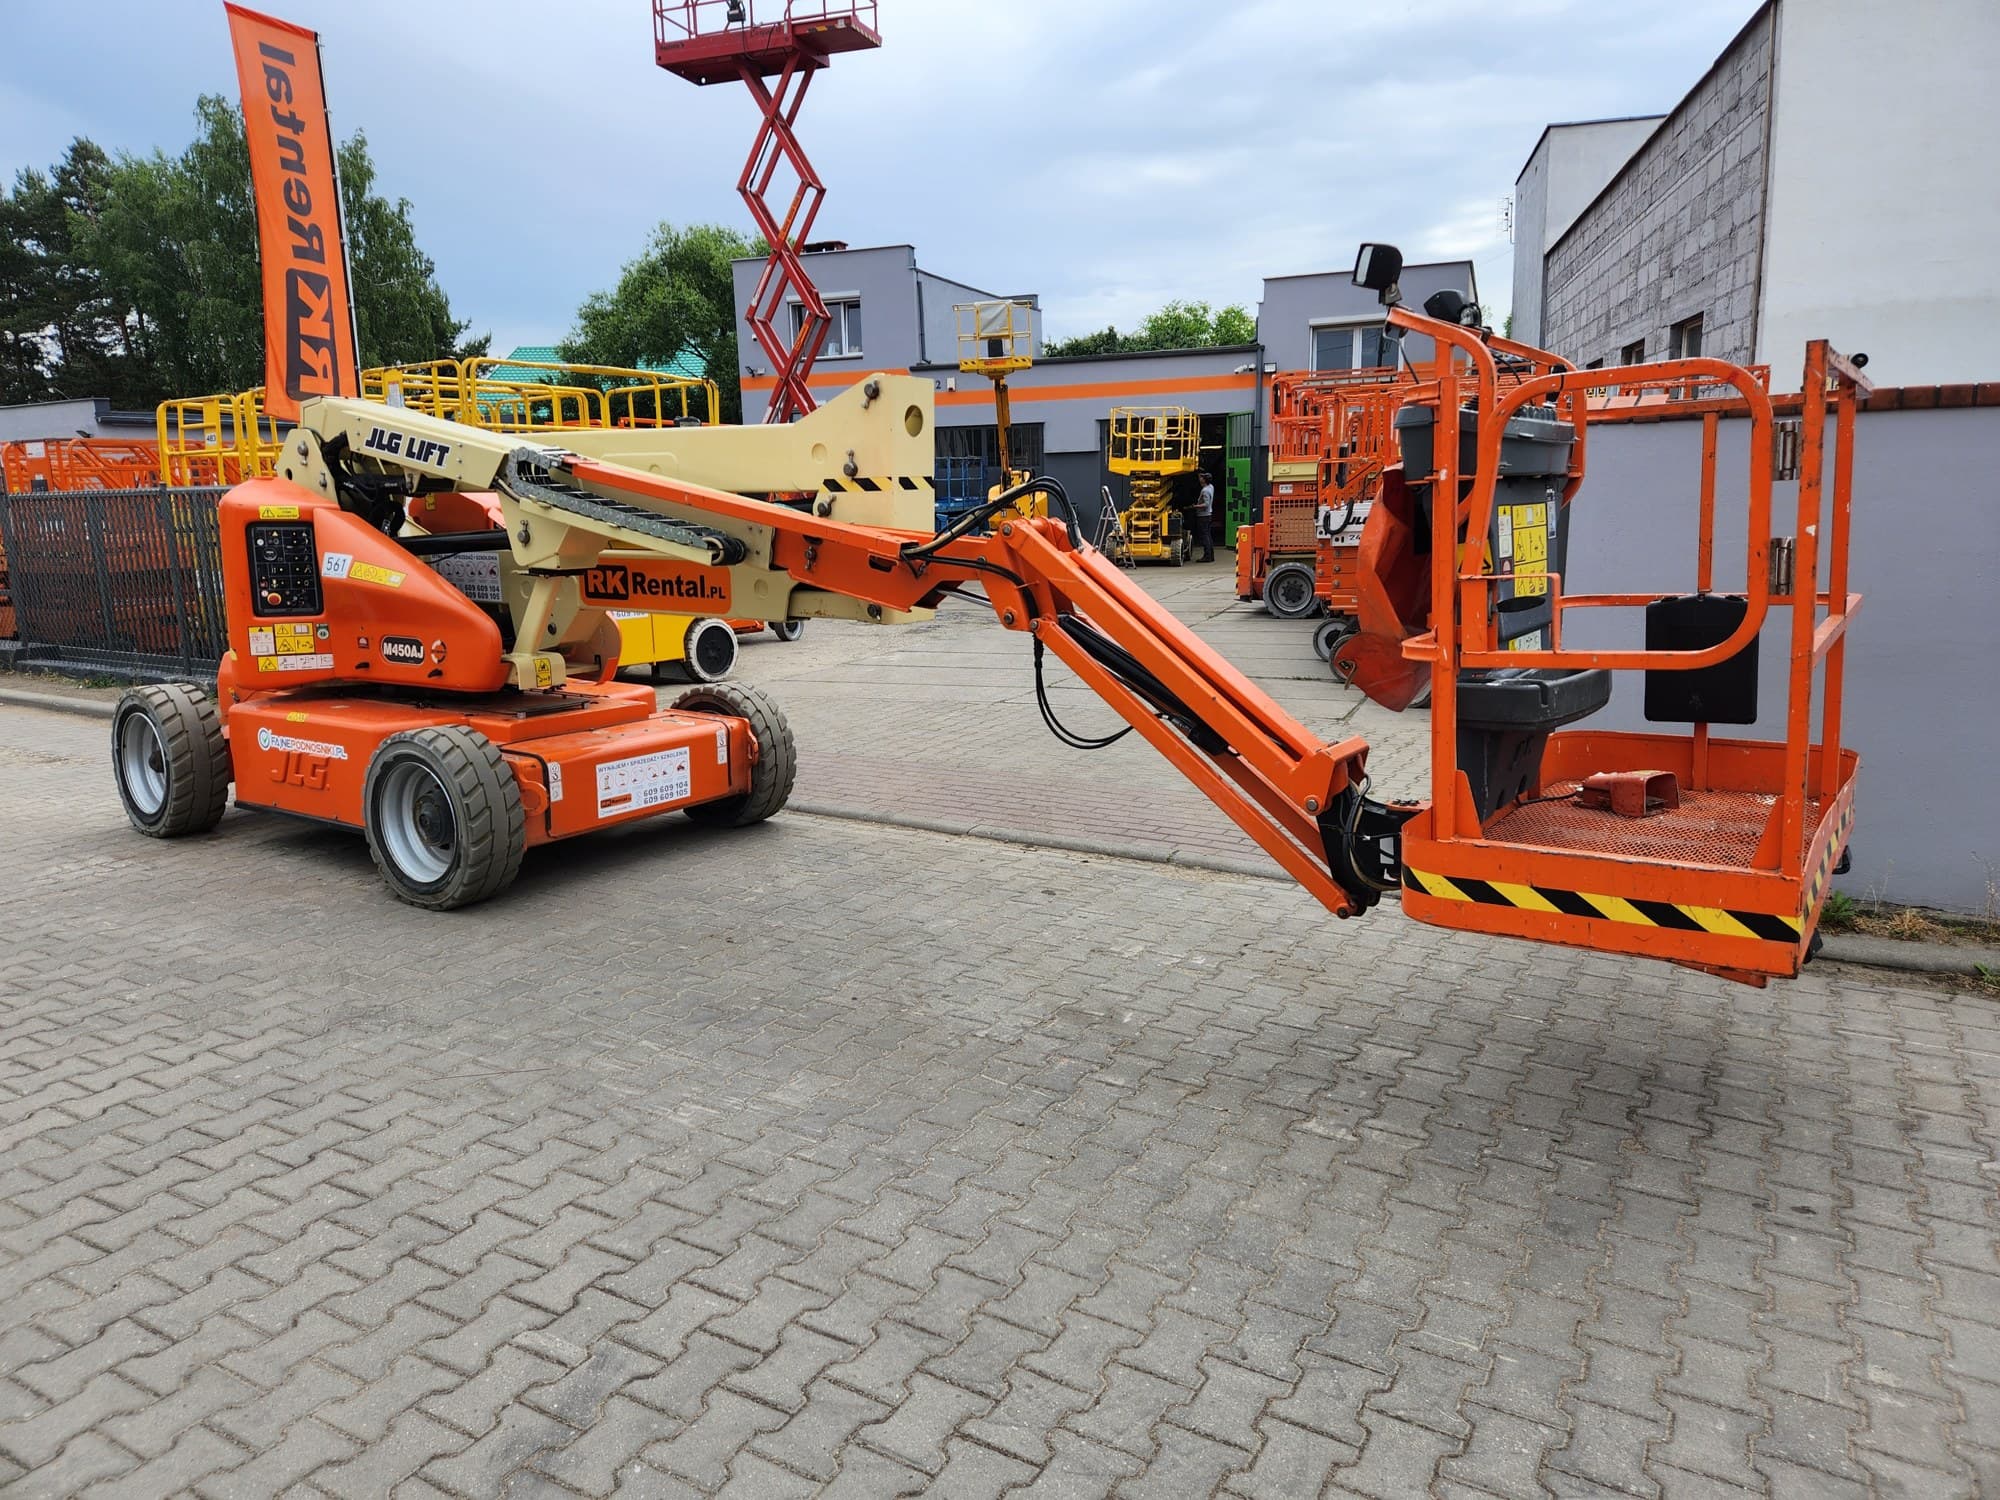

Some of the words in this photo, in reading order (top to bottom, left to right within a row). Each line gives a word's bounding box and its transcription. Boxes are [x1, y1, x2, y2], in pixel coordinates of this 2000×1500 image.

[365, 427, 403, 455] JLG
[405, 436, 450, 467] LIFT
[326, 556, 346, 572] 561
[464, 584, 476, 592] 609
[476, 584, 488, 592] 609
[489, 585, 500, 593] 104
[586, 569, 627, 595] RK
[383, 642, 424, 659] M450AJ
[270, 750, 330, 790] JLG
[643, 788, 658, 797] 609
[659, 784, 674, 794] 609
[676, 780, 689, 789] 104
[643, 796, 658, 805] 609
[660, 792, 674, 801] 609
[676, 788, 689, 797] 105
